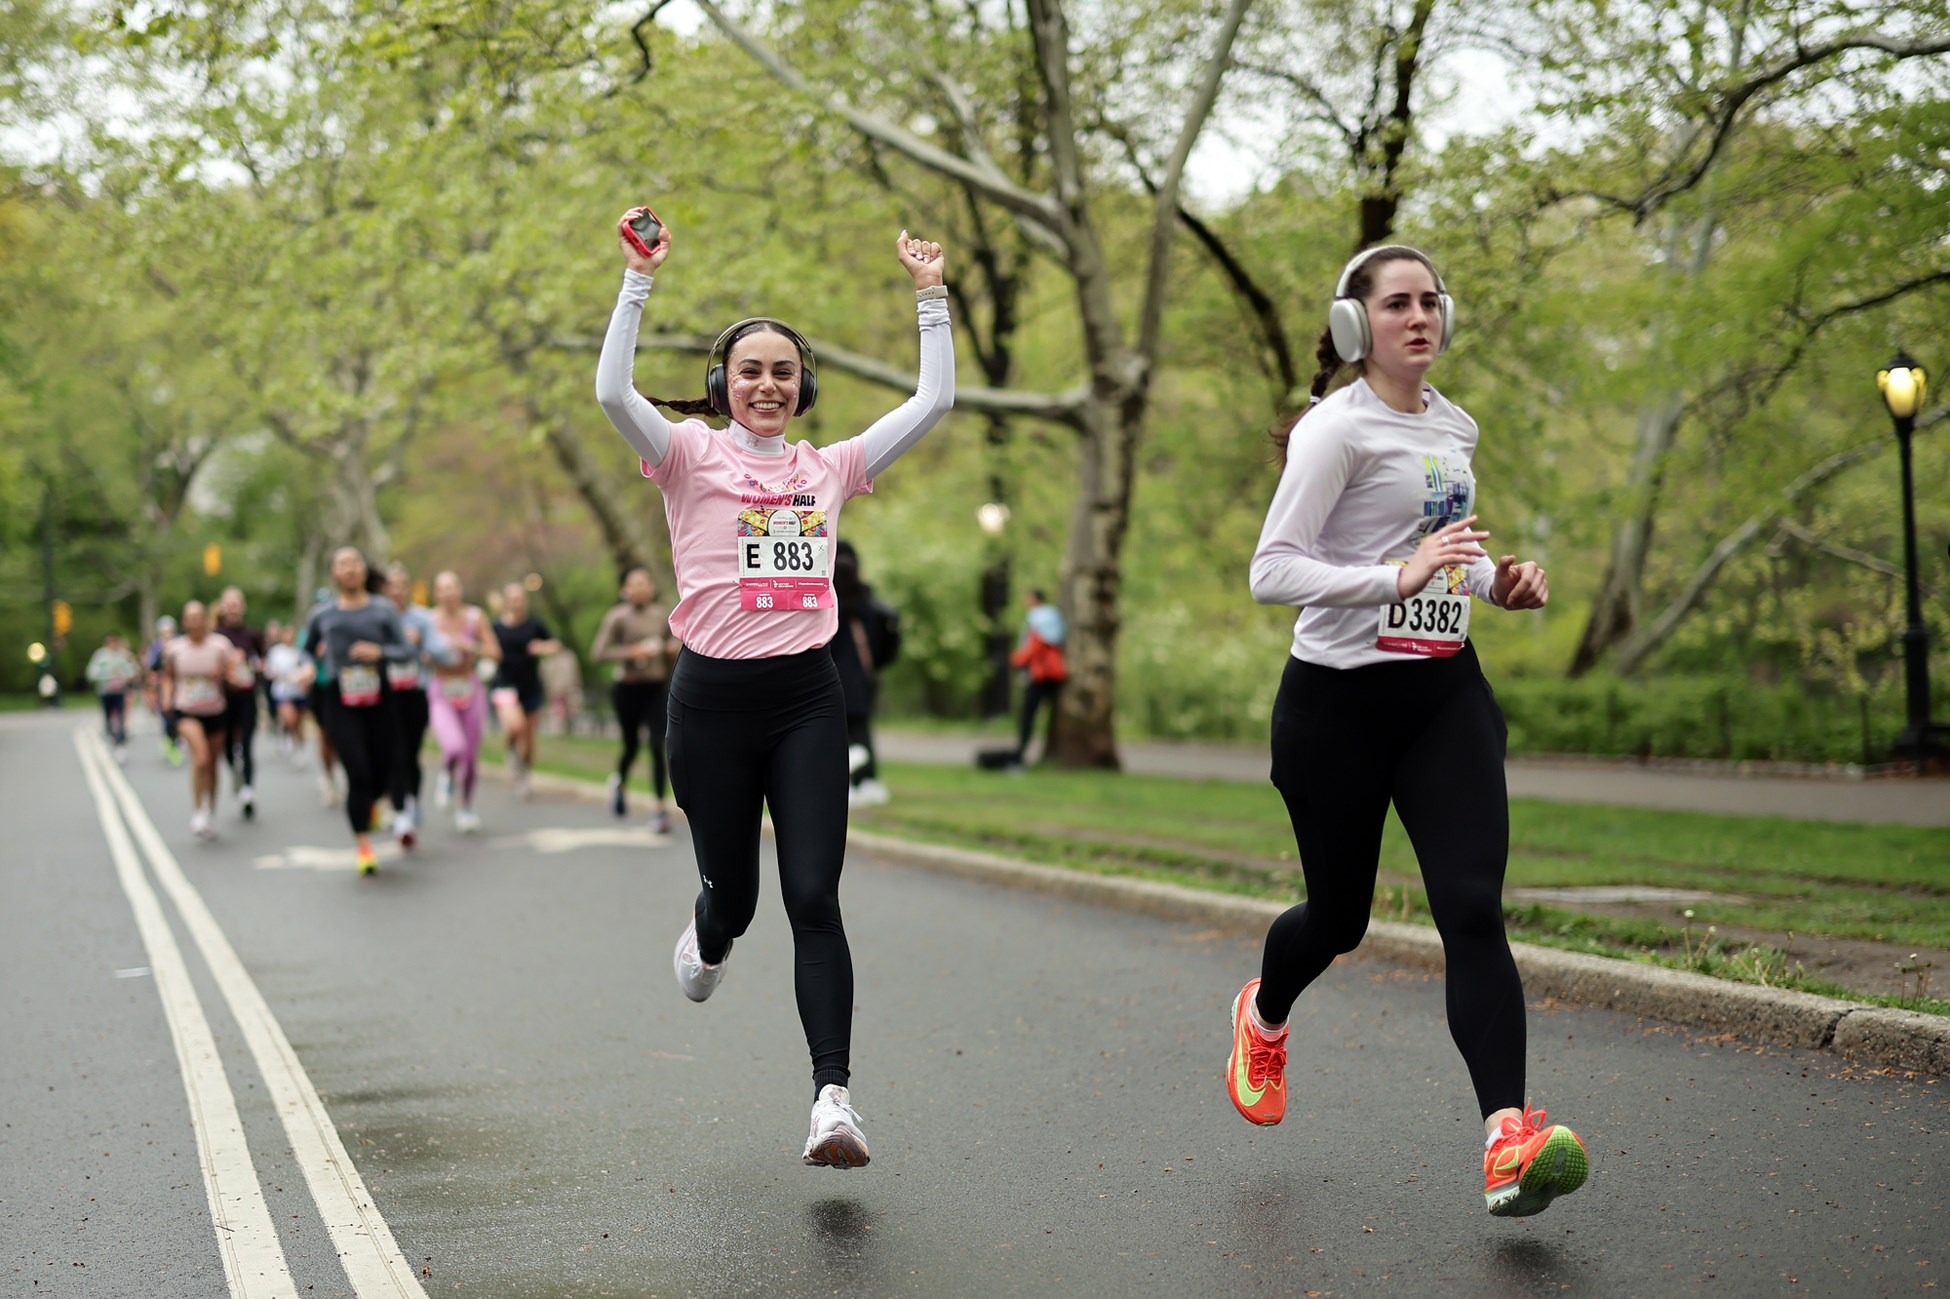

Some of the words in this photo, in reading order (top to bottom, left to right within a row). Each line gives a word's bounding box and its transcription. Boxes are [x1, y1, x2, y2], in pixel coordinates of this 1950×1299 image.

[741, 494, 793, 506] WOMEN'S
[792, 495, 816, 506] HALF
[746, 543, 761, 569] E
[773, 542, 814, 571] 883
[756, 596, 773, 608] 883
[802, 596, 818, 608] 883
